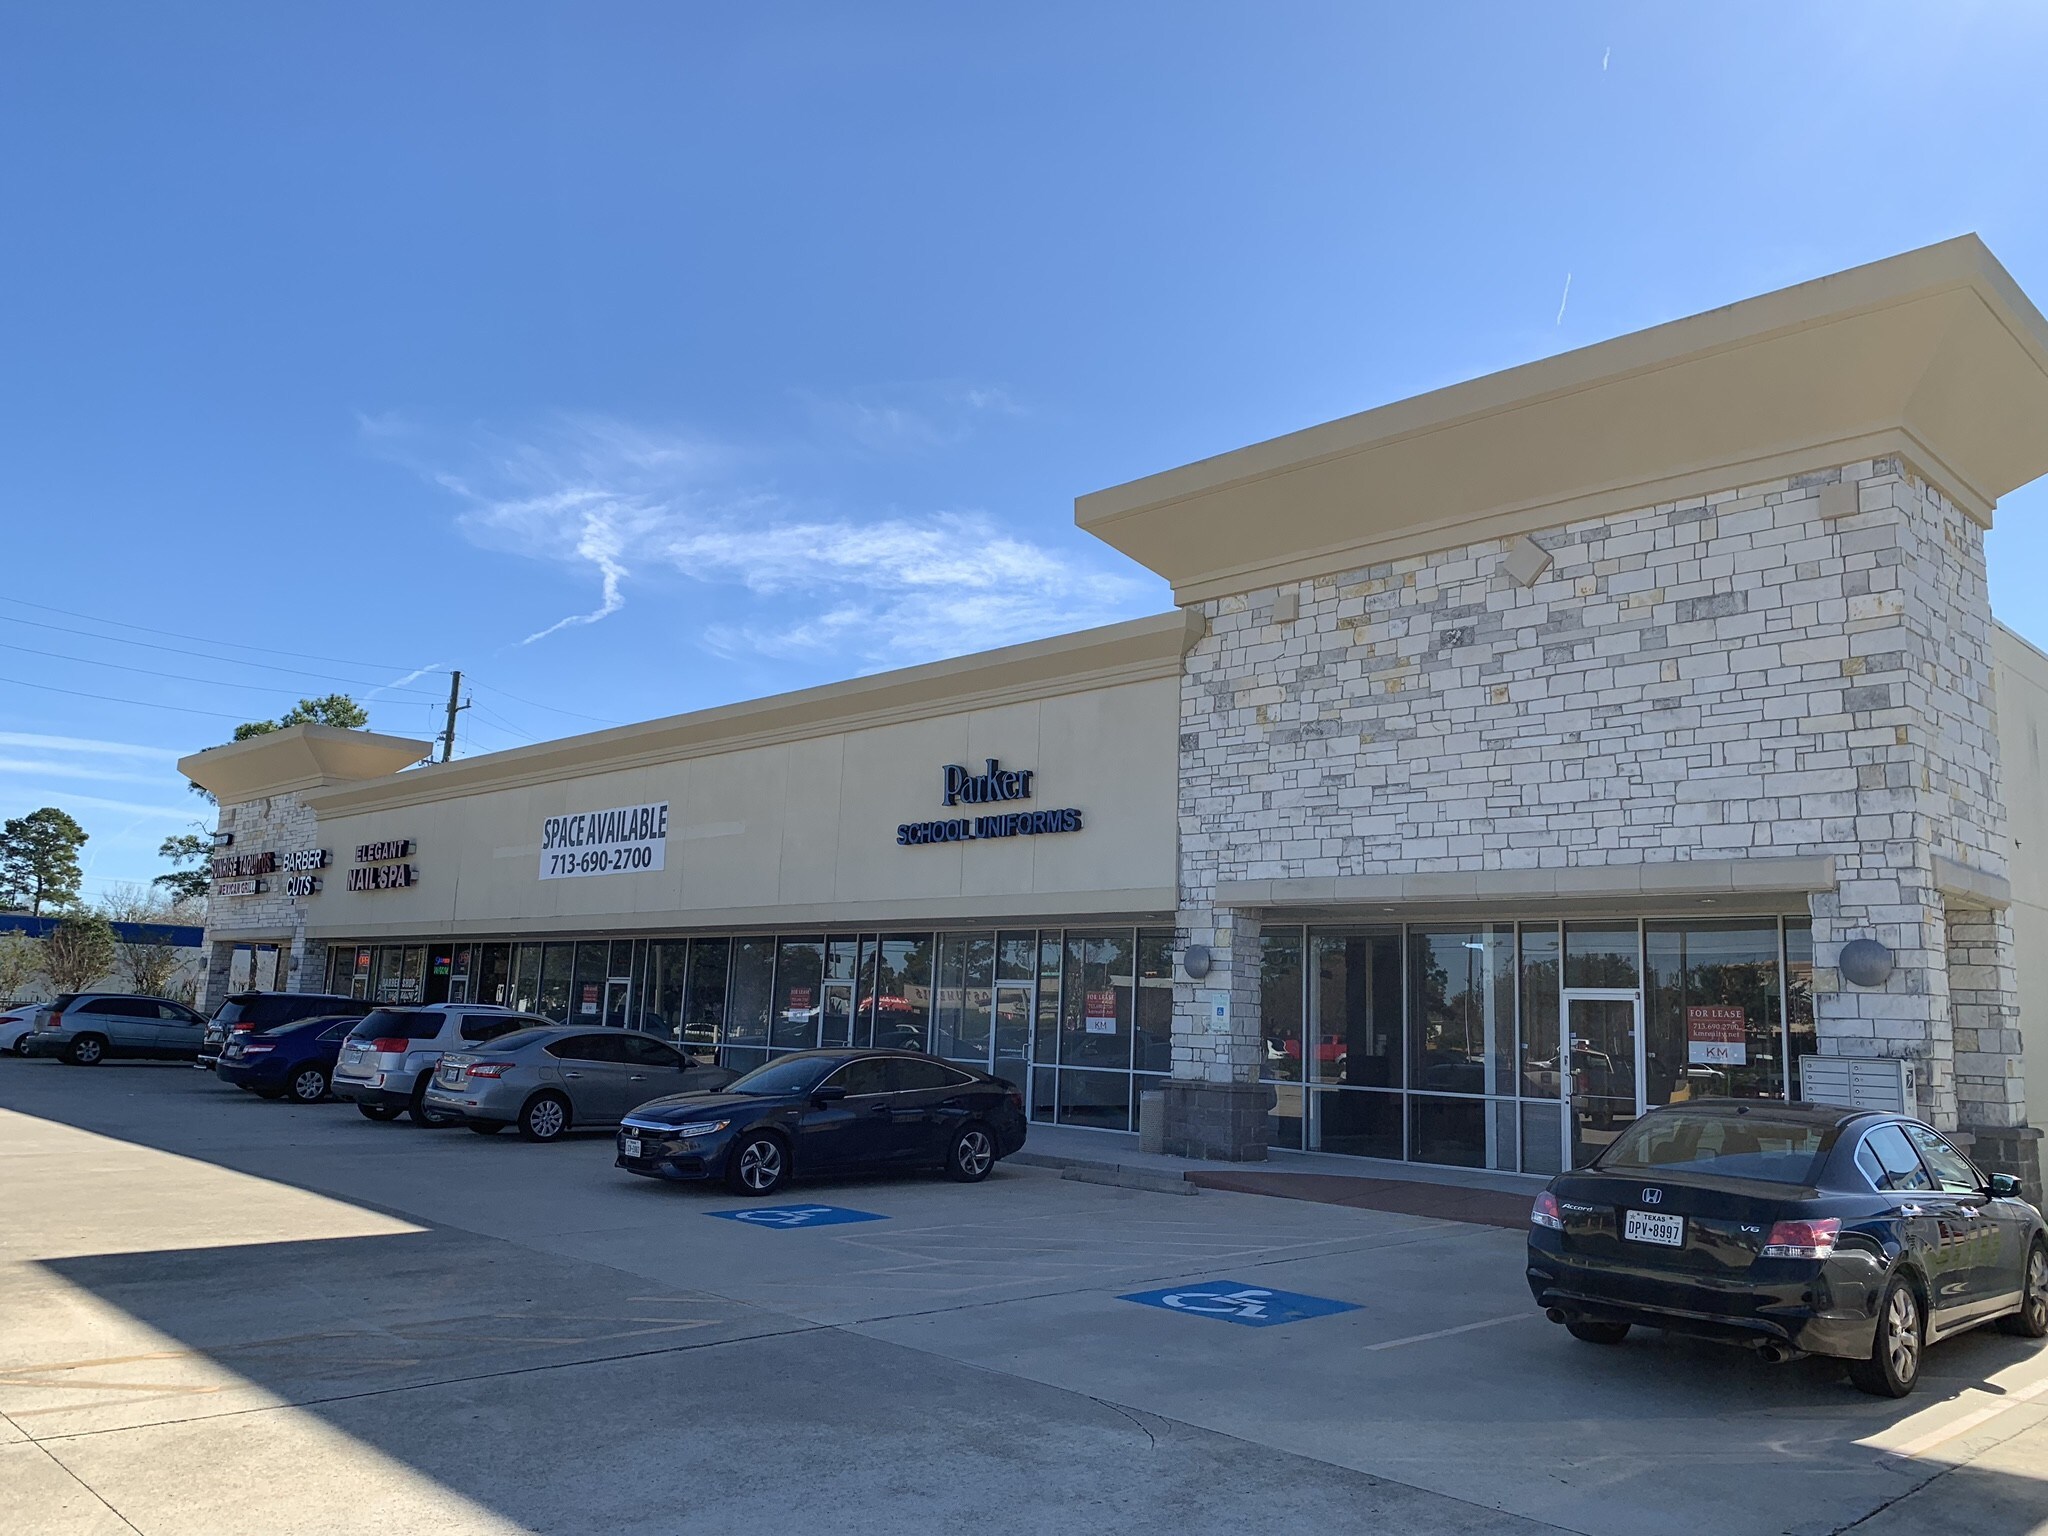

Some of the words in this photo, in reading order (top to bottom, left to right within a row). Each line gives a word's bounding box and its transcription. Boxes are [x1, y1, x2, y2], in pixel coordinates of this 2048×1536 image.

[942, 759, 1033, 806] Parker
[543, 815, 585, 850] SPACE
[586, 805, 668, 845] AVAILABLE
[897, 819, 972, 845] SCHOOL
[975, 808, 1081, 838] UNIFORMS
[282, 849, 325, 872] BARBER
[355, 840, 407, 862] ELEGANT
[550, 846, 652, 875] 713-690-2700
[211, 856, 237, 878] SUNRISE
[240, 853, 273, 876] TAQUITOS
[286, 876, 313, 896] CUTS
[347, 867, 377, 891] NAIL
[379, 864, 408, 888] SPA
[1690, 1009, 1708, 1017] FOR
[1712, 1009, 1742, 1018] LEASE
[1706, 1047, 1728, 1058] KM
[1561, 1203, 1593, 1212] Accord
[1643, 1214, 1666, 1222] TEXAS
[1740, 1225, 1760, 1233] V6
